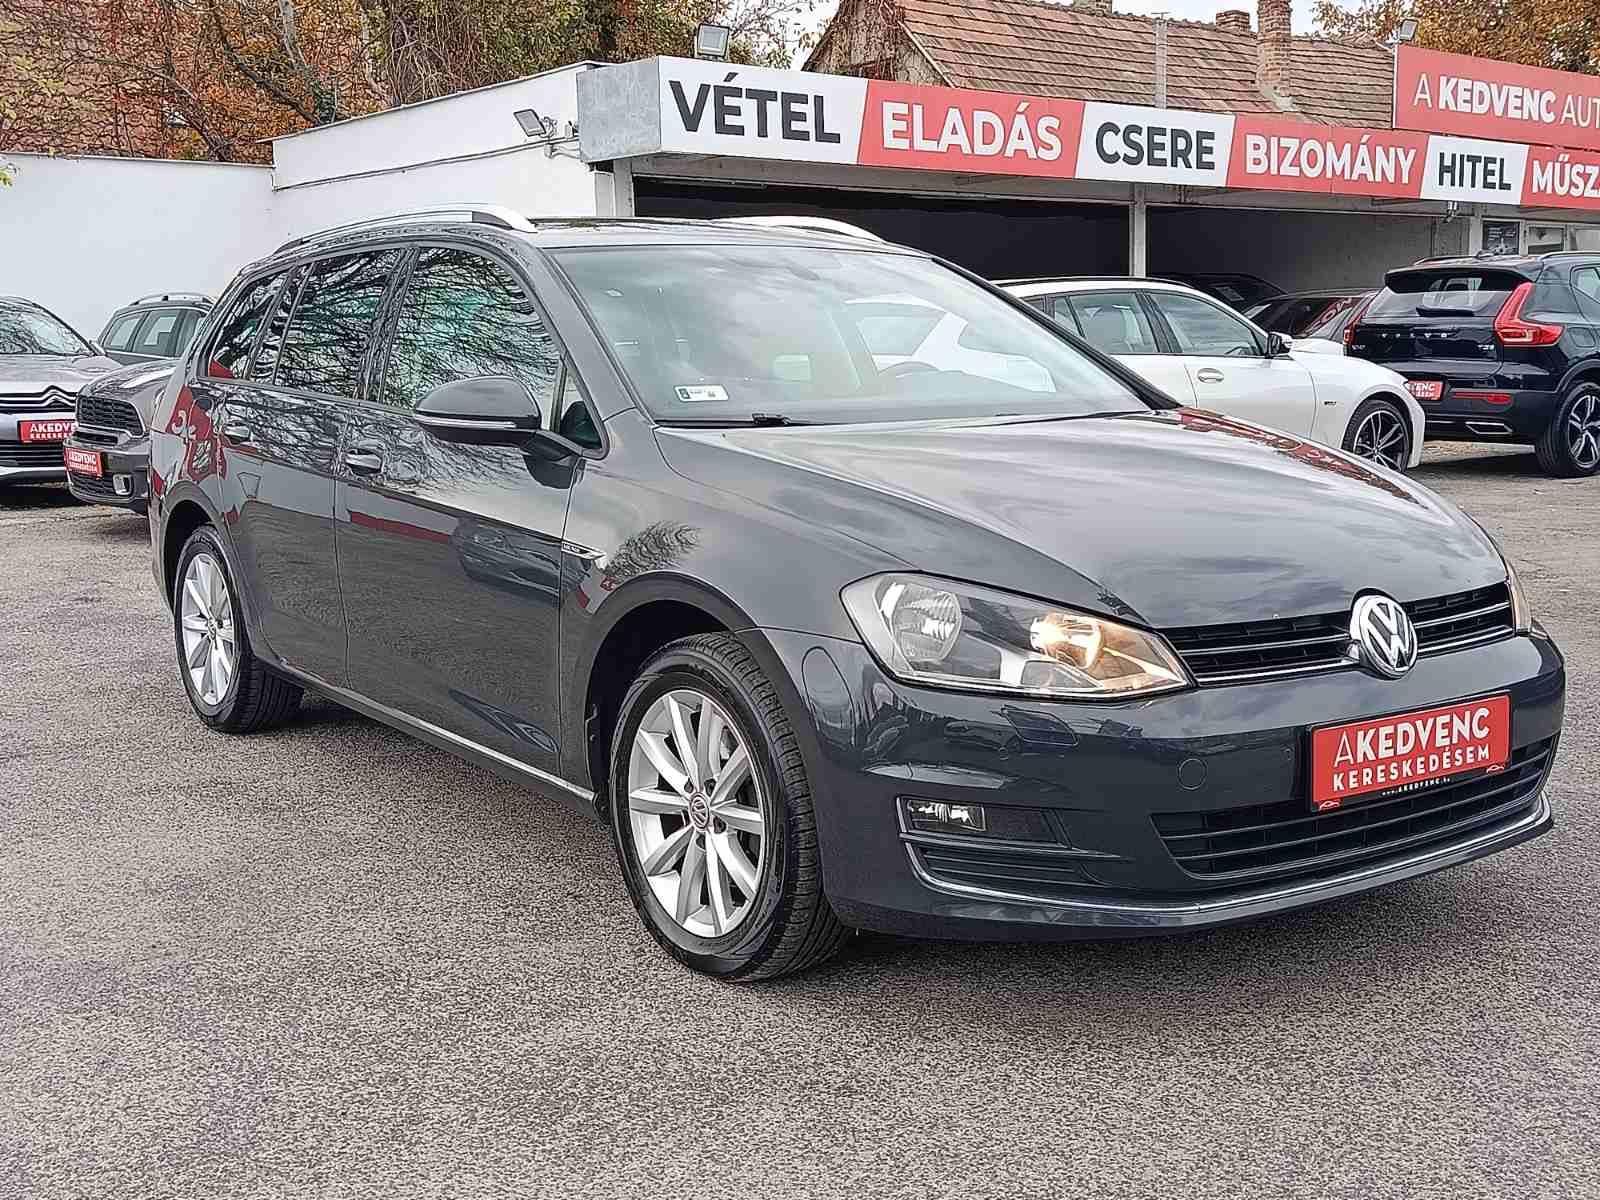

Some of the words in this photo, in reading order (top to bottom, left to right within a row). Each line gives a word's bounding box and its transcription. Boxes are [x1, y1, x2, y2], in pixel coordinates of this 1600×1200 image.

[669, 72, 841, 144] VÉTEL
[1413, 73, 1433, 108] A
[1438, 75, 1557, 124] KEDVENC
[881, 101, 1063, 162] ELADÁS
[1094, 120, 1216, 171] CSERE
[1245, 133, 1418, 185] BIZOMÁNY
[1438, 151, 1512, 191] HITEL
[1531, 153, 1600, 198] MŰSZ
[1332, 743, 1490, 792] KERESKEDÉSEM
